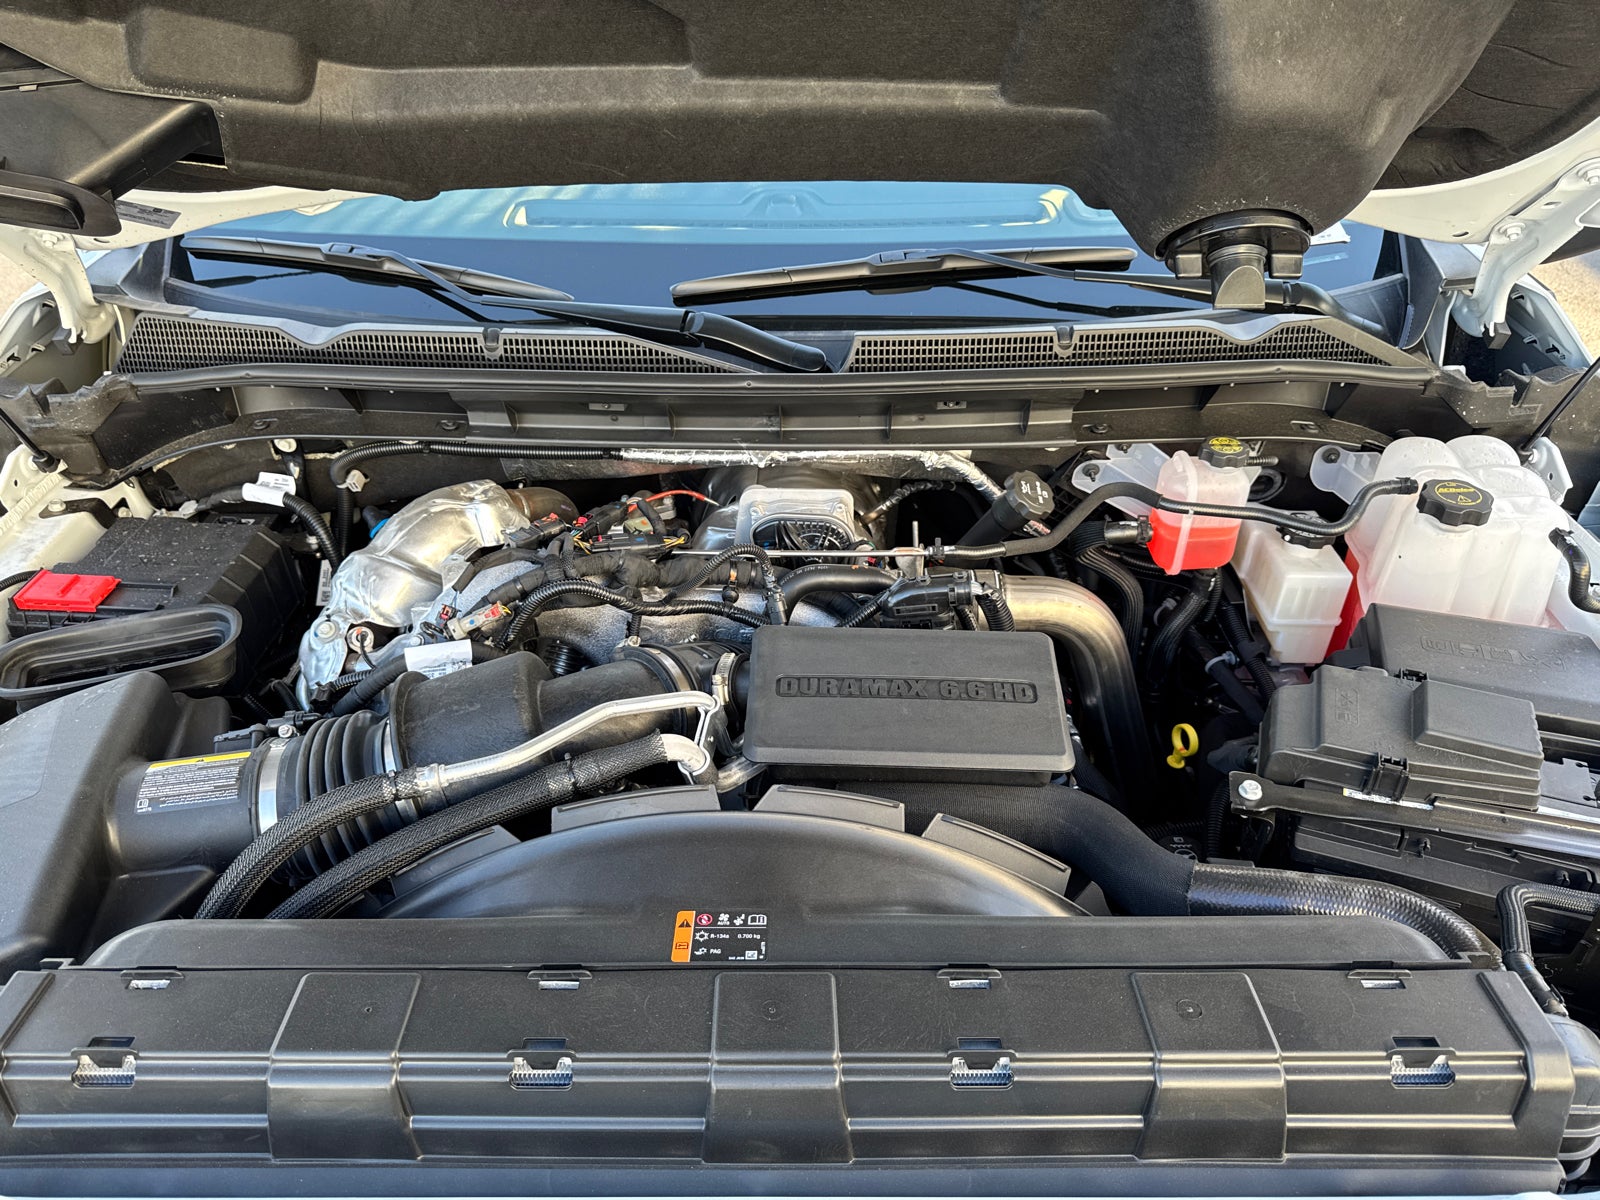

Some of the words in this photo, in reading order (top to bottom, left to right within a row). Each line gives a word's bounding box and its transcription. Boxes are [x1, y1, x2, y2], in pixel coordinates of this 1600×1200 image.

[780, 677, 928, 698] DURAMAX
[939, 680, 987, 700] 6.6
[993, 682, 1034, 702] HD
